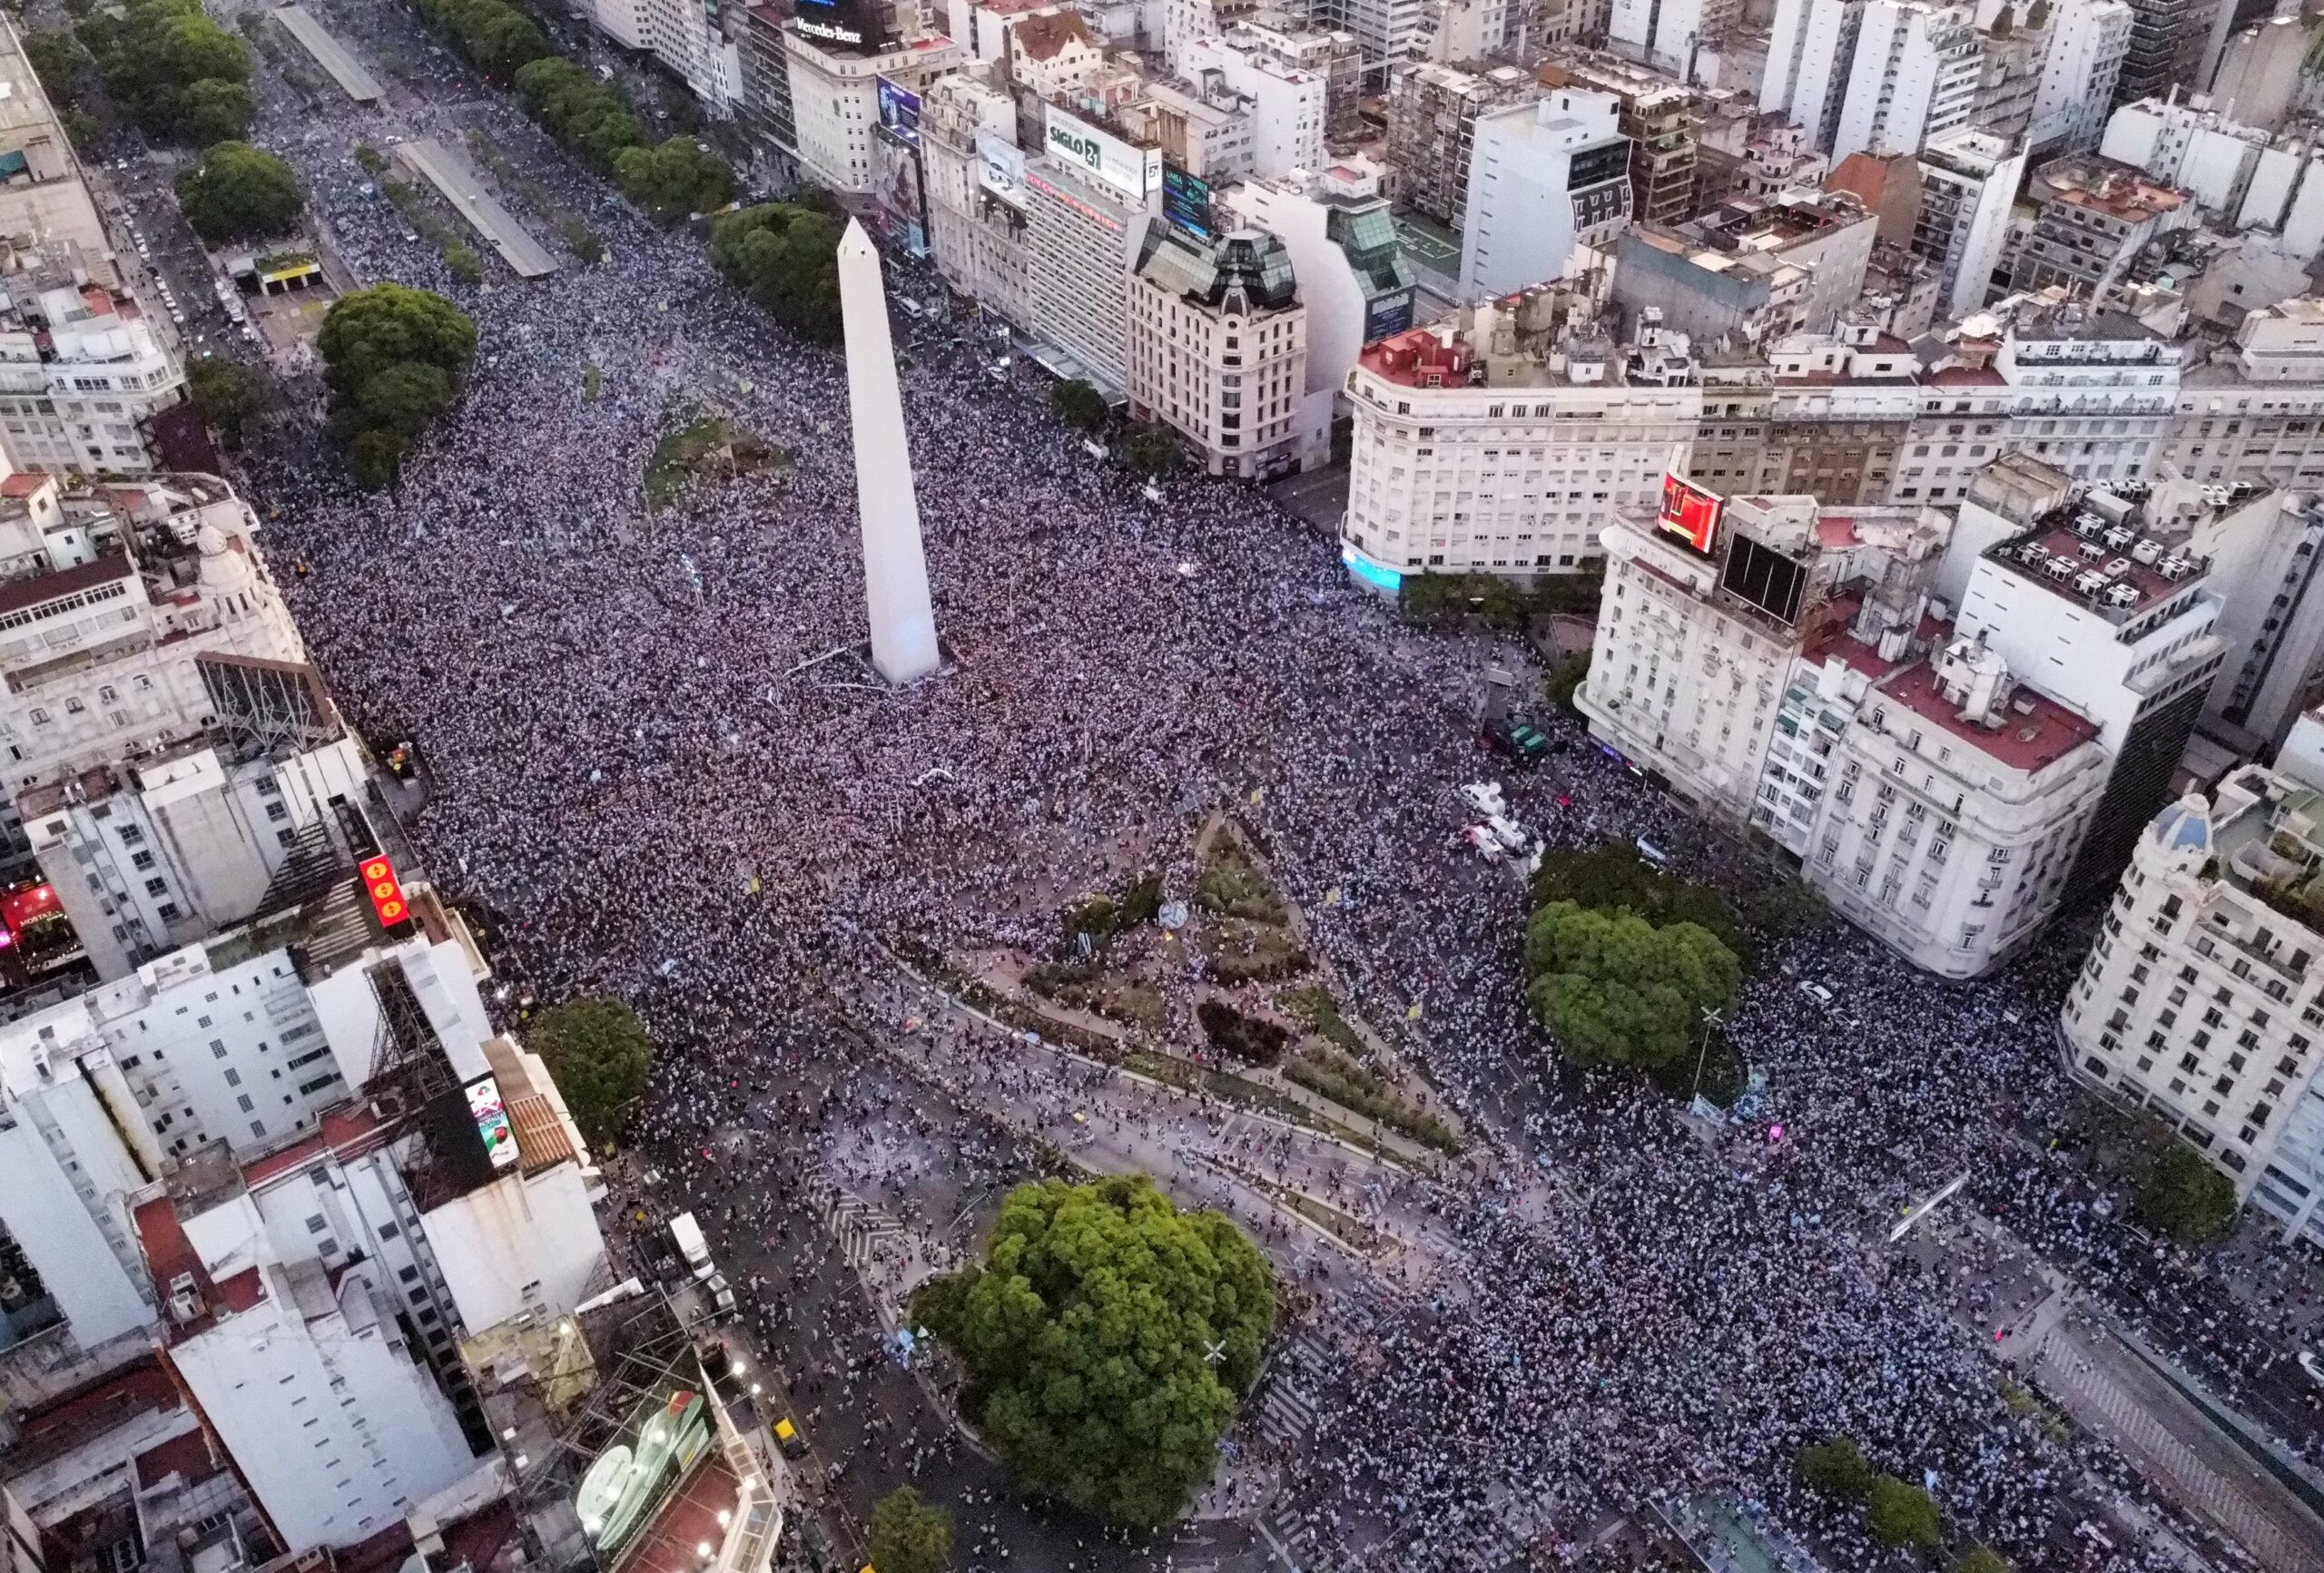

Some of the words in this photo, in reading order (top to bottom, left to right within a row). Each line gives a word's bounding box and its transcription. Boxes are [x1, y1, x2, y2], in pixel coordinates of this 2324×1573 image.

[793, 16, 862, 44] Mercedes-Benz
[1049, 126, 1084, 155] SIGLO
[1086, 144, 1098, 170] 21
